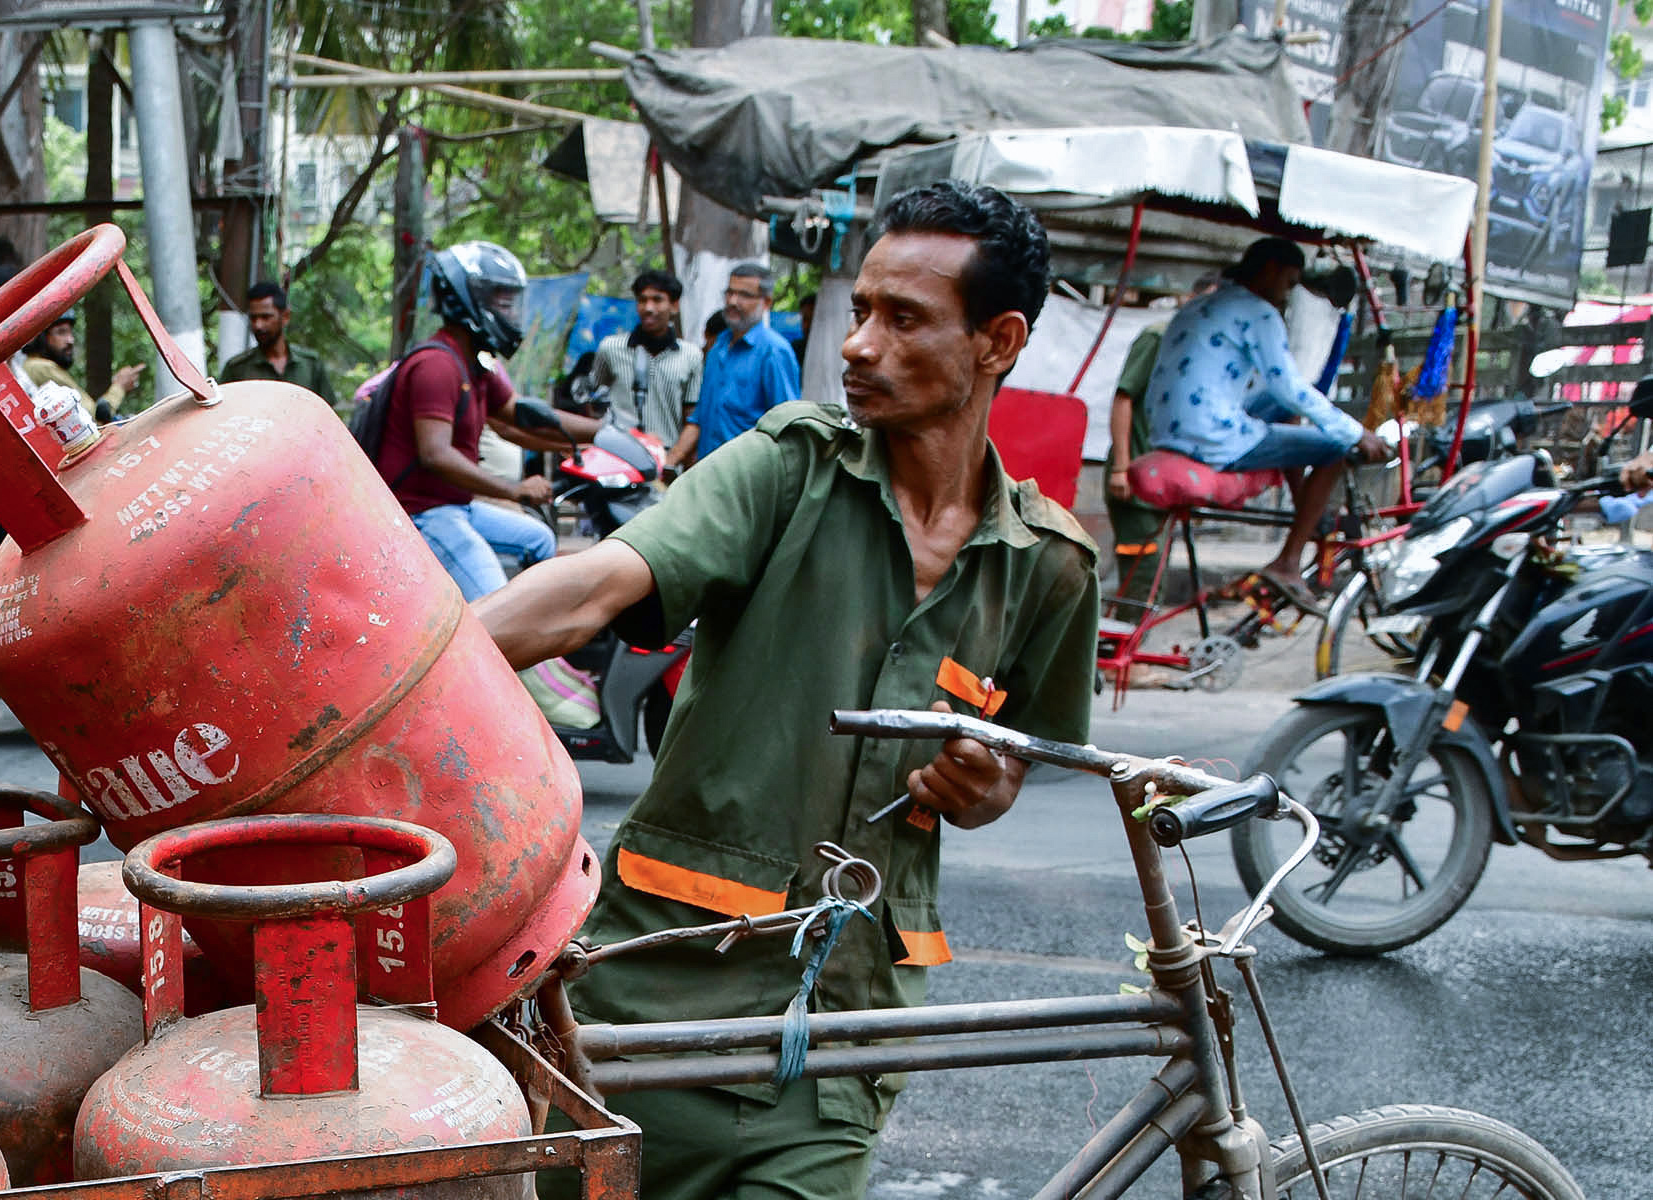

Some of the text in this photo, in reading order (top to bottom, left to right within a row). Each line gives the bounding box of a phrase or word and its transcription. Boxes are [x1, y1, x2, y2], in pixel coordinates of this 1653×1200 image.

[105, 435, 161, 478] 15.7
[116, 482, 165, 526] NETT
[130, 494, 193, 540] GROSS
[148, 914, 166, 998] 15.8
